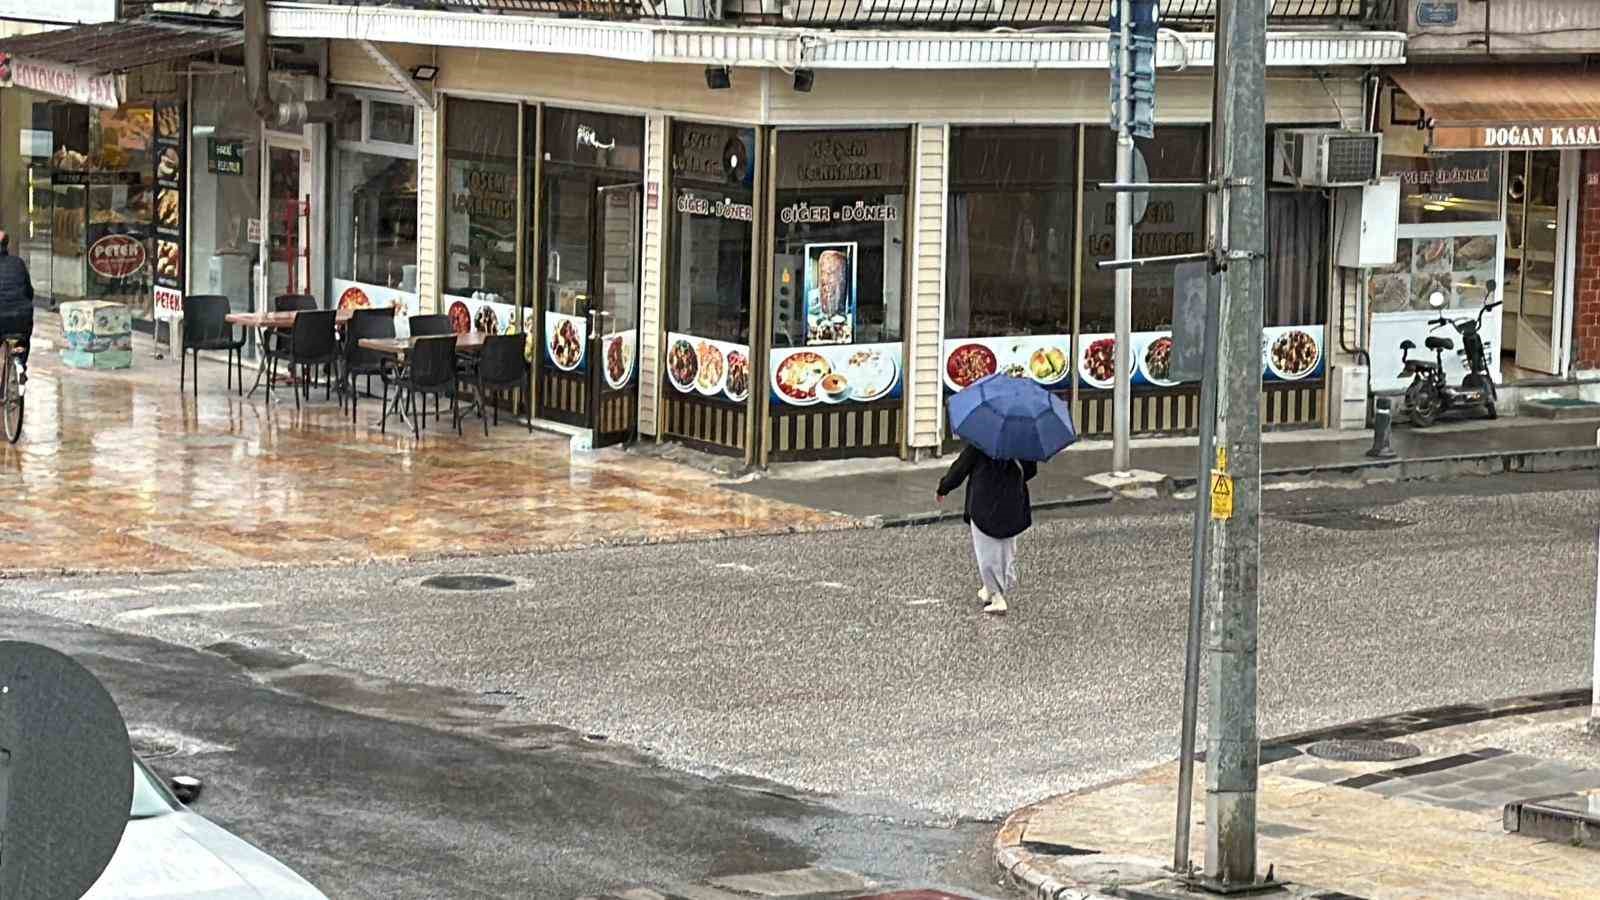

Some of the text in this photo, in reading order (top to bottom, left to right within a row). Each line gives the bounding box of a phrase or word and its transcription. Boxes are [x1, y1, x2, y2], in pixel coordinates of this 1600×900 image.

[1484, 125, 1600, 146] DOĞAN KASA
[841, 200, 897, 222] DÖNER
[156, 291, 181, 311] PETEK
